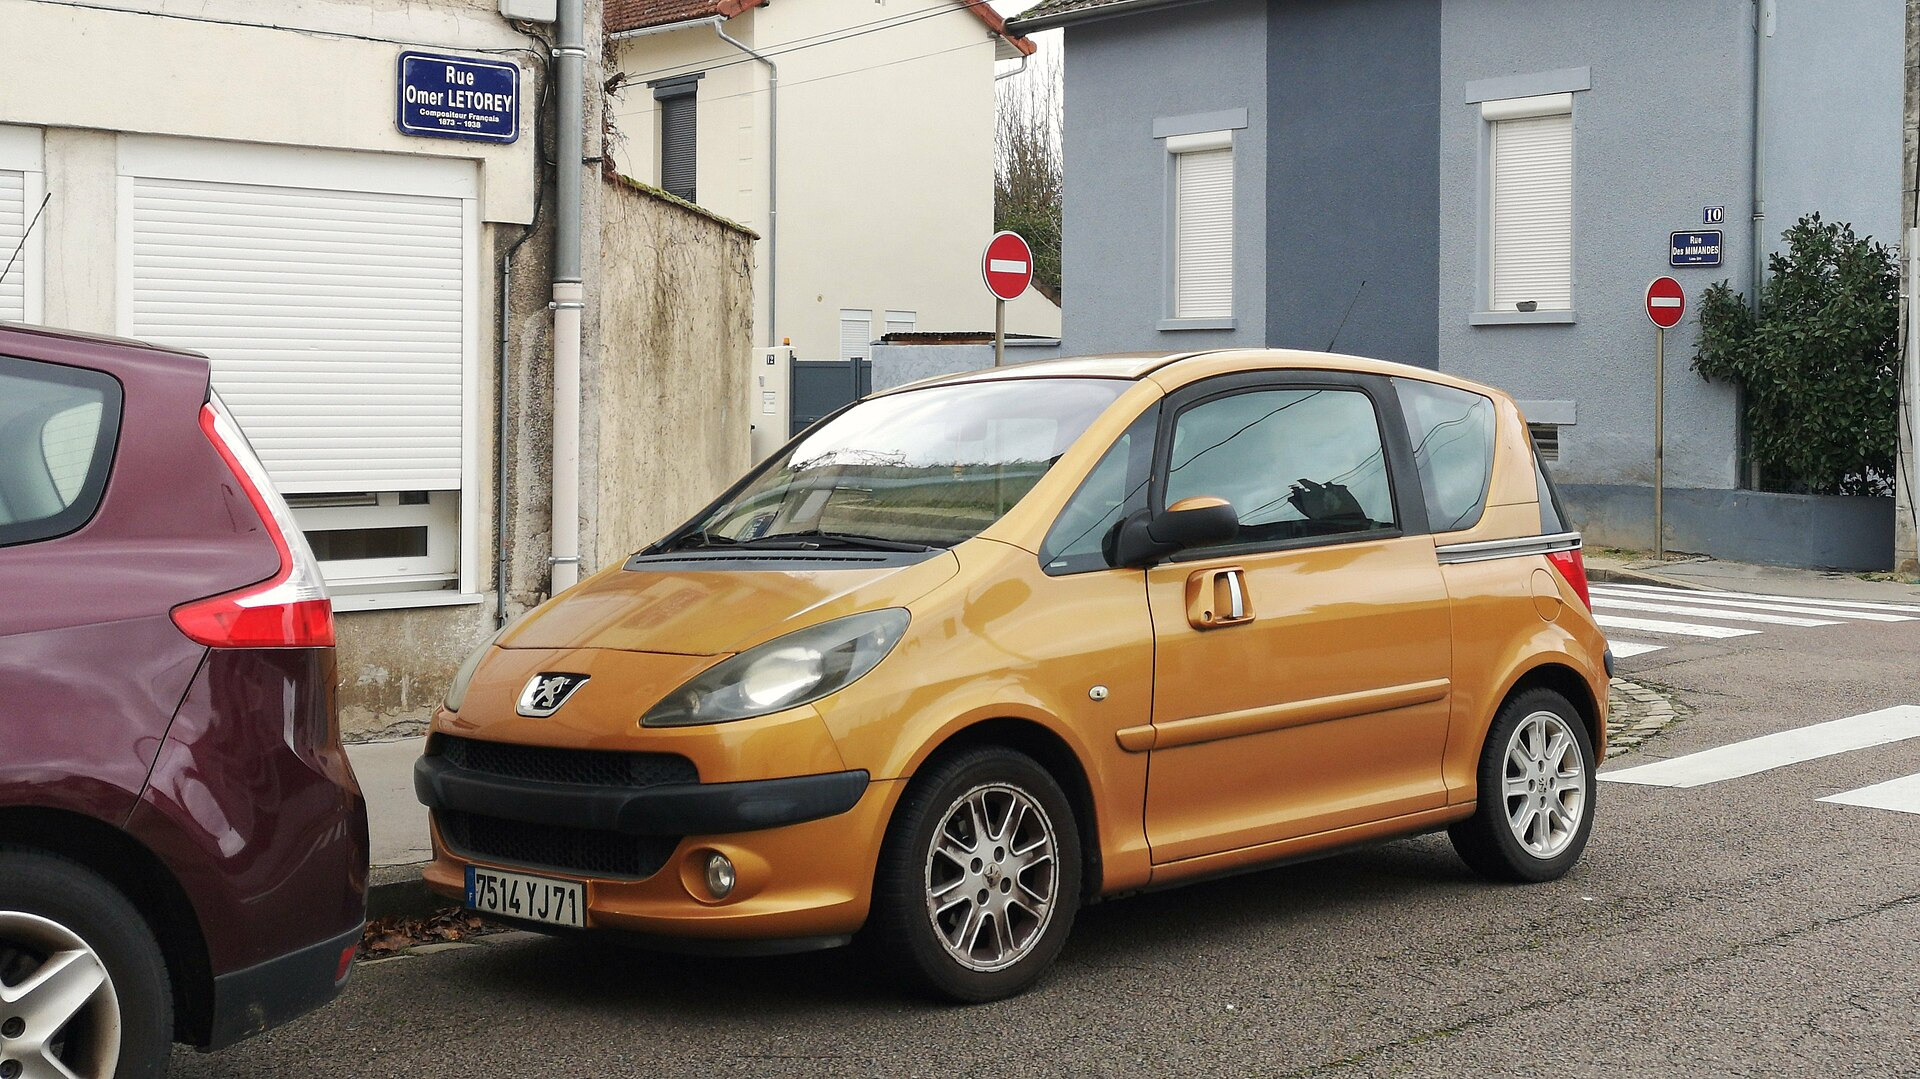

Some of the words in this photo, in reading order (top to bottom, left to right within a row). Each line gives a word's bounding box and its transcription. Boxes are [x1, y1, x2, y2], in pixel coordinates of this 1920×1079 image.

[446, 65, 474, 86] Rue
[406, 84, 444, 106] Omer
[448, 89, 512, 112] LETOREY
[419, 108, 467, 120] Compositeur
[468, 112, 500, 123] Français
[438, 118, 455, 126] 1873
[1707, 208, 1722, 223] 10
[1689, 235, 1702, 244] Rue
[1672, 246, 1684, 256] Des
[1684, 245, 1719, 255] MIMANDES
